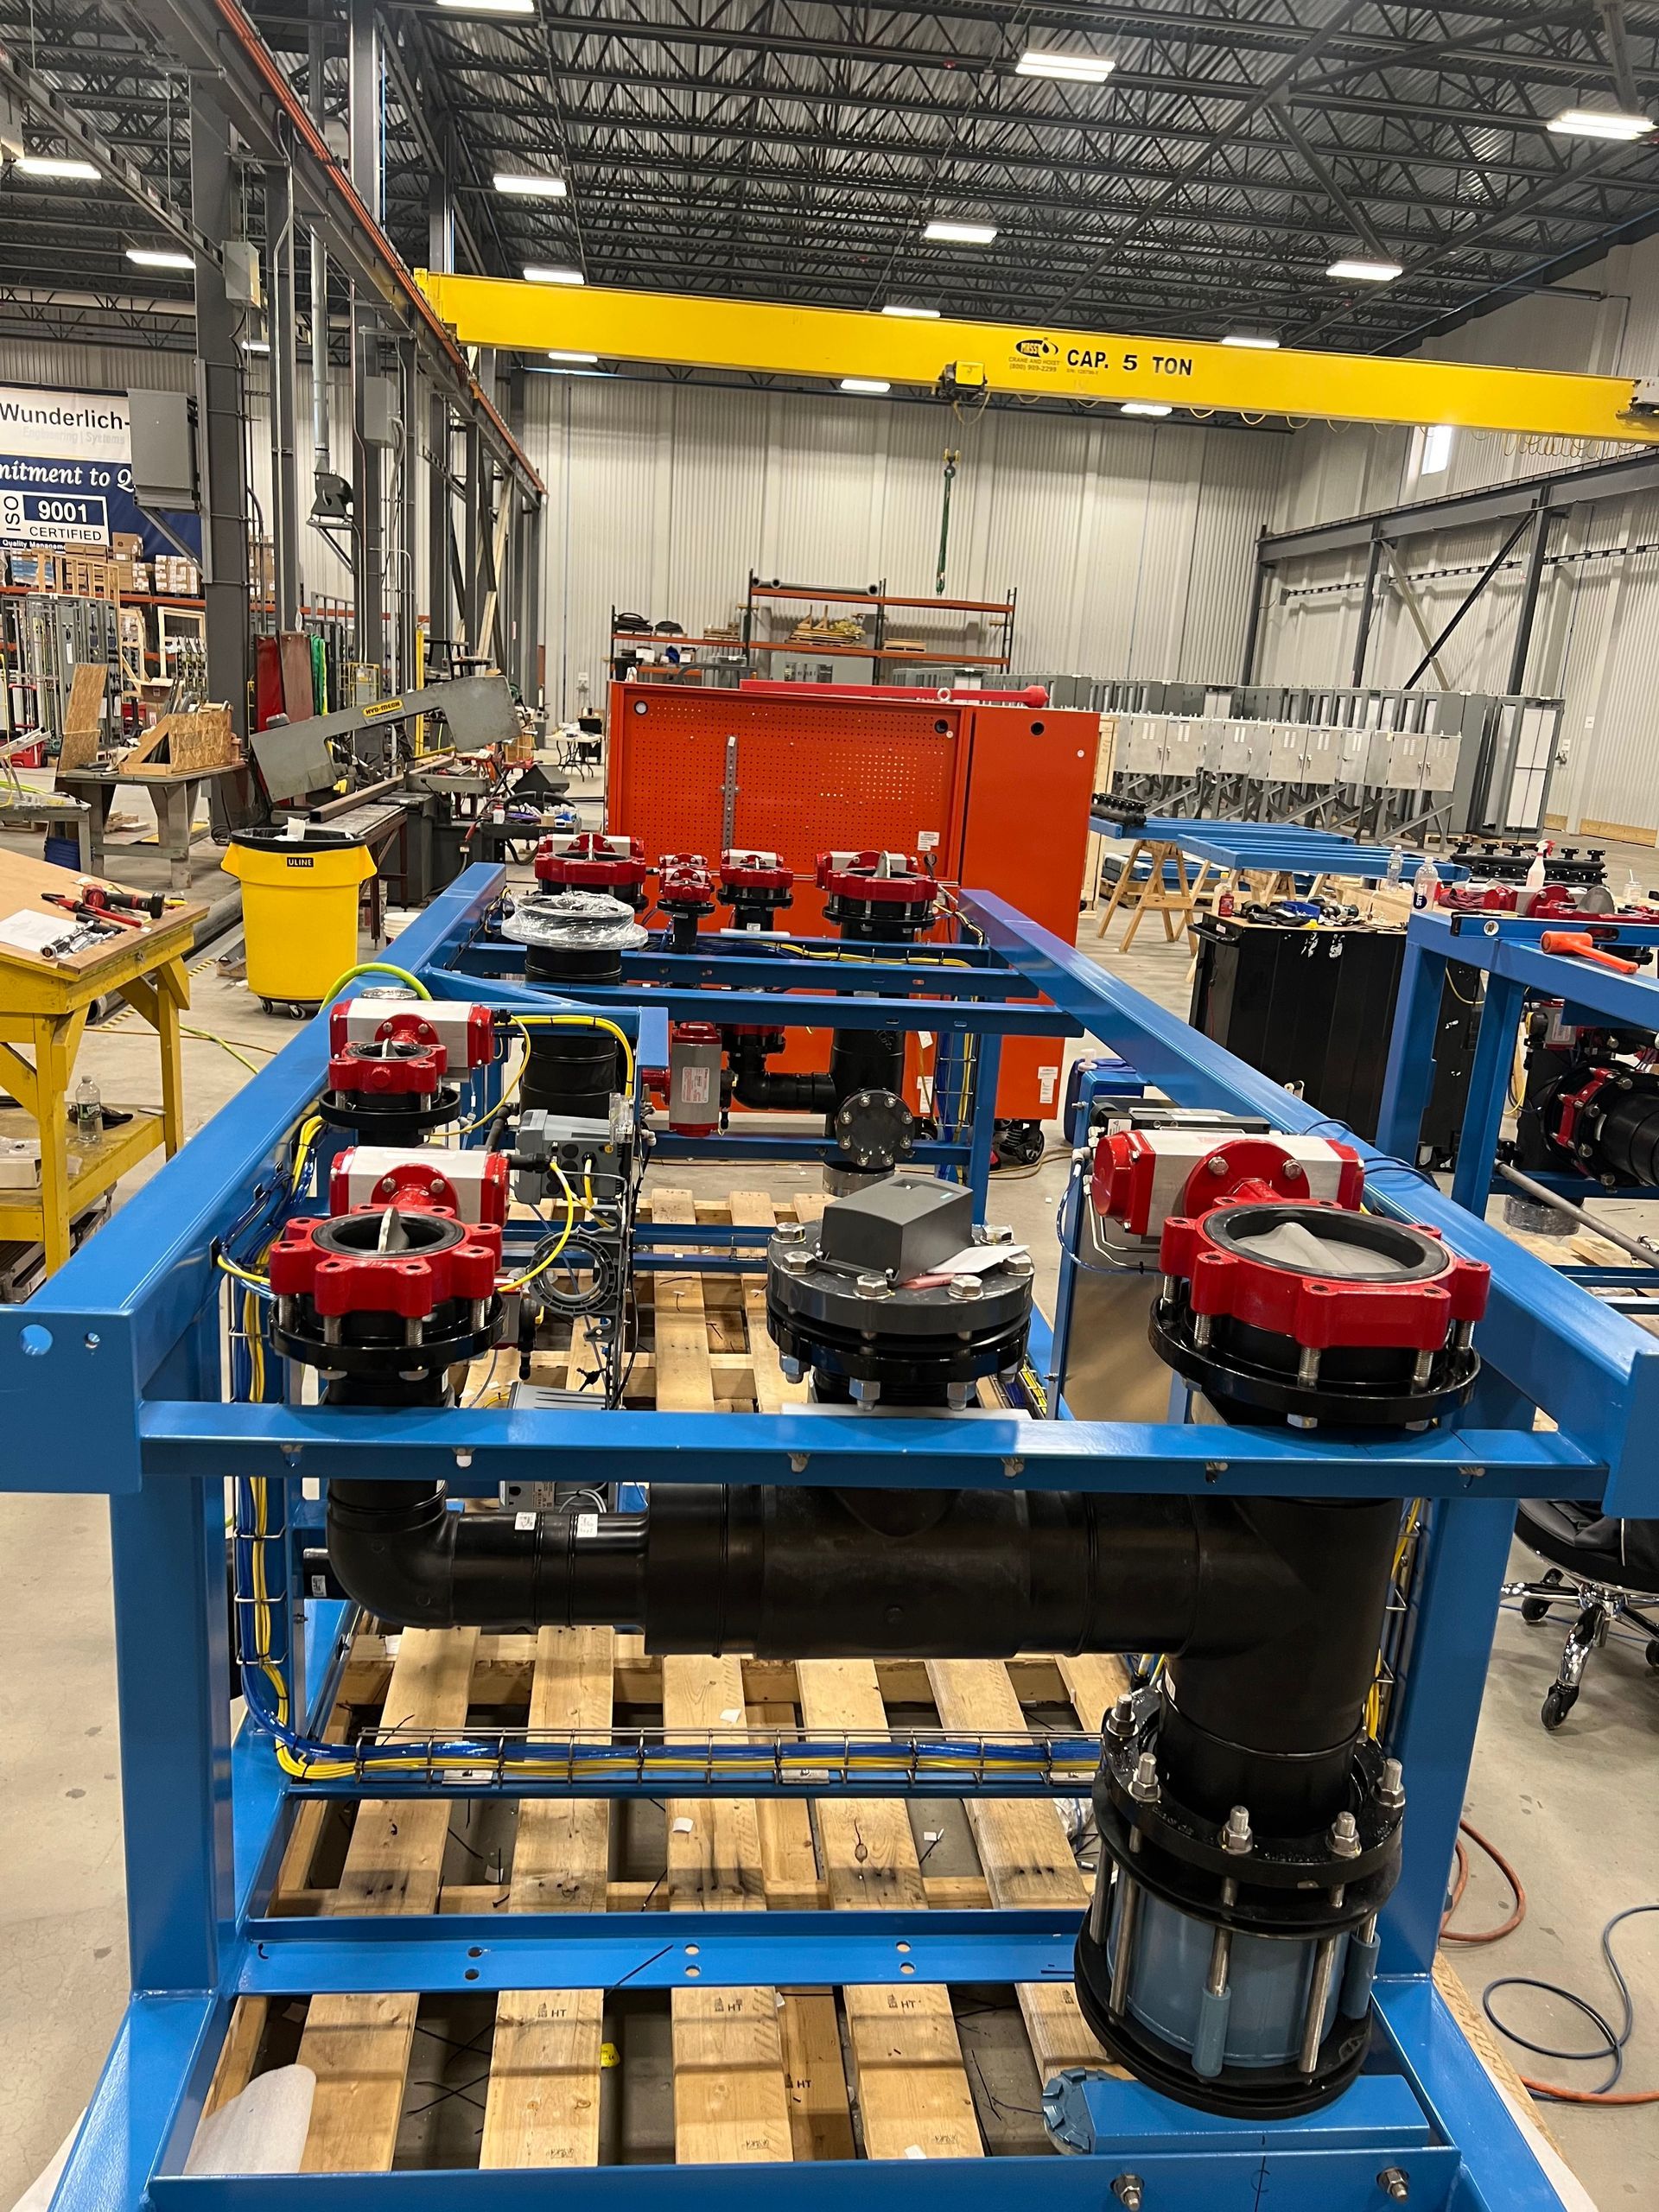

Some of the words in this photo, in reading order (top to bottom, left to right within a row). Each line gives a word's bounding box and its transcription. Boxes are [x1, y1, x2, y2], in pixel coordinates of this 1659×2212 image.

[1067, 349, 1109, 369] CAP.
[1122, 354, 1138, 371] 5
[1153, 356, 1192, 376] TON
[23, 426, 79, 443] Engineering
[86, 431, 125, 446] Systems
[90, 467, 111, 487] to
[3, 496, 21, 531] ISO
[38, 499, 87, 523] 9001
[29, 526, 102, 541] CERTIFIED
[2, 538, 28, 549] Quality
[365, 701, 401, 715] HYD-MECH
[288, 858, 312, 867] ULINE
[728, 2003, 742, 2012] HT
[901, 2000, 916, 2009] HT
[551, 2009, 567, 2018] HT
[797, 2078, 812, 2088] HT
